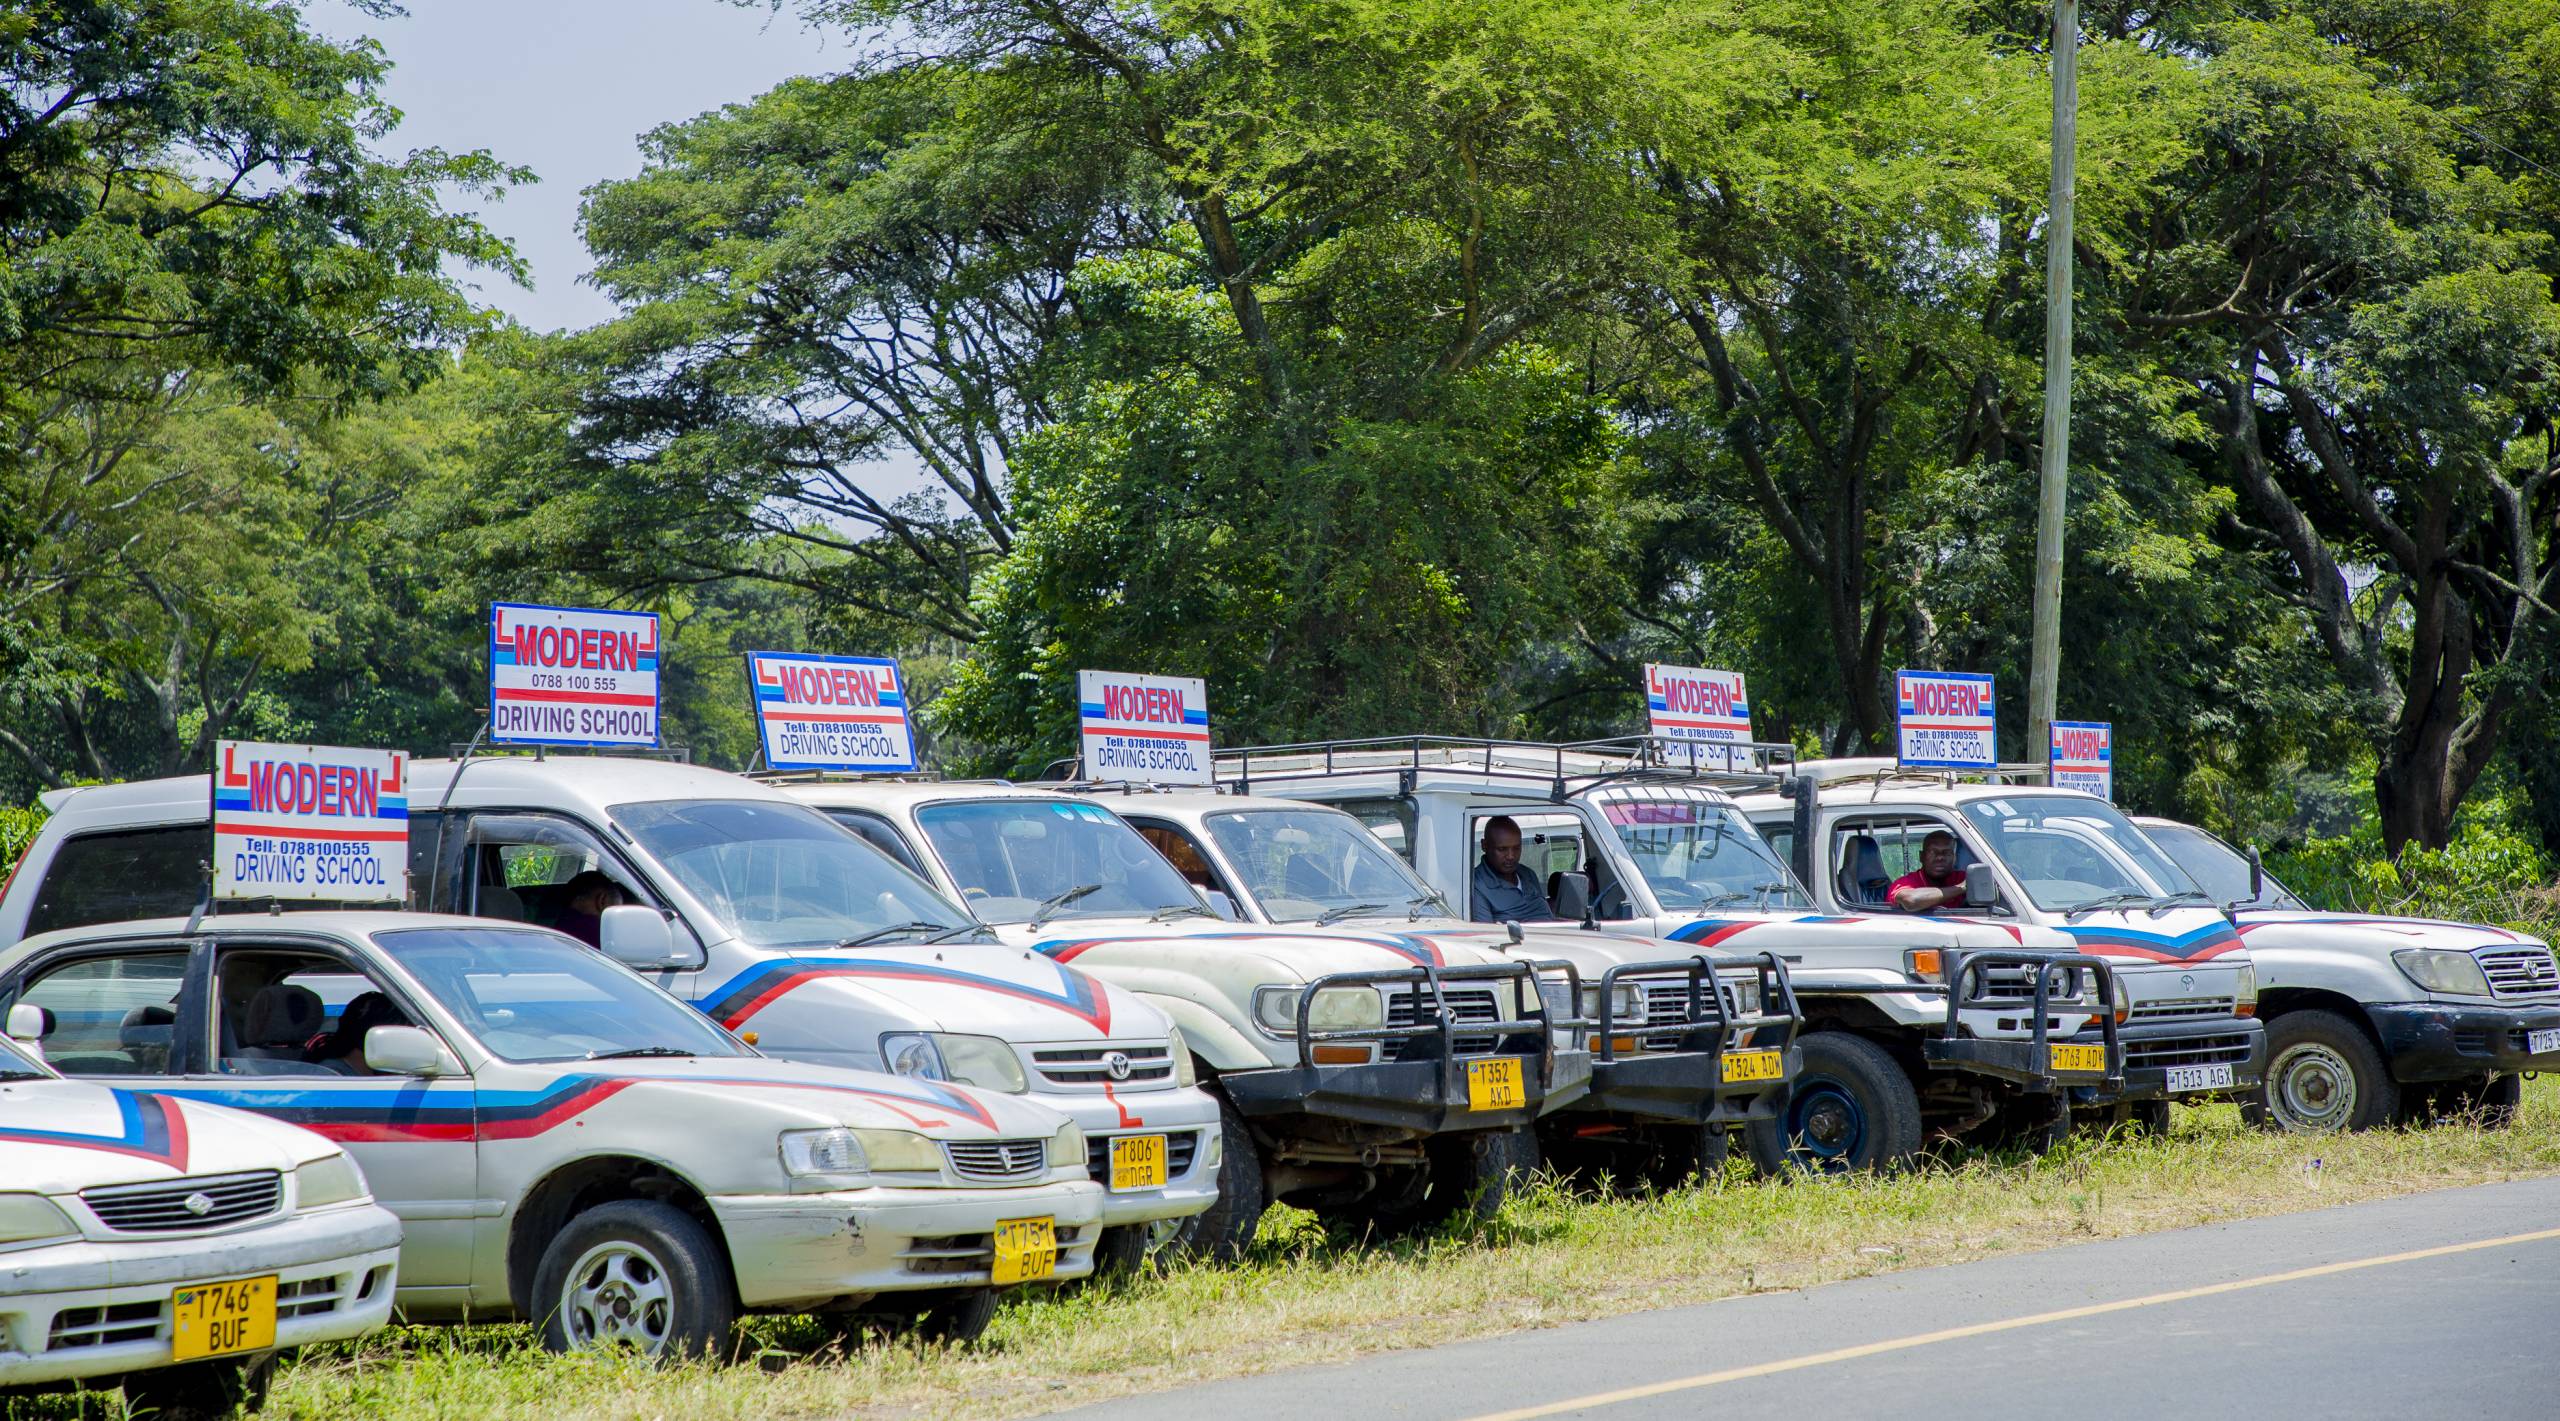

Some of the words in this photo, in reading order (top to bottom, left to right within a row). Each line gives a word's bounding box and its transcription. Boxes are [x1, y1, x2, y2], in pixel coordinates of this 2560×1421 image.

[515, 624, 638, 672] MODERN
[532, 674, 562, 688] 0788
[568, 676, 589, 689] 100
[594, 678, 616, 690] 555
[780, 666, 880, 707] MODERN
[1104, 685, 1184, 724] MODERN
[1664, 678, 1732, 716] MODERN
[1913, 683, 1978, 716] MODERN
[498, 705, 574, 733] DRIVING
[581, 709, 653, 736] SCHOOL
[784, 722, 808, 733] Tell:
[812, 723, 882, 734] 0788100555
[780, 734, 837, 756] DRIVING
[842, 736, 898, 757] SCHOOL
[1128, 740, 1186, 750] 0788100555
[1688, 728, 1734, 739] 0788100555
[1932, 731, 1978, 740] 0788100555
[2062, 730, 2099, 760] MODERN
[1098, 748, 1145, 769] DRIVING
[1150, 750, 1197, 771] SCHOOL
[1910, 740, 1945, 757] DRIVING
[1951, 741, 1986, 759] SCHOOL
[250, 760, 378, 817] MODERN
[246, 838, 276, 852] Tell:
[280, 840, 370, 856] 0788100555
[236, 854, 304, 884] DRIVING
[316, 856, 385, 885] SCHOOL
[1480, 1063, 1508, 1085] T352
[1730, 1058, 1755, 1079] T524
[2175, 1070, 2202, 1088] T513
[2210, 1068, 2231, 1086] AGX
[1490, 1086, 1511, 1106] AKD
[1122, 1139, 1152, 1164] T806
[1021, 1250, 1054, 1277] BUF
[196, 1283, 248, 1319] T746
[210, 1317, 248, 1351] BUF
